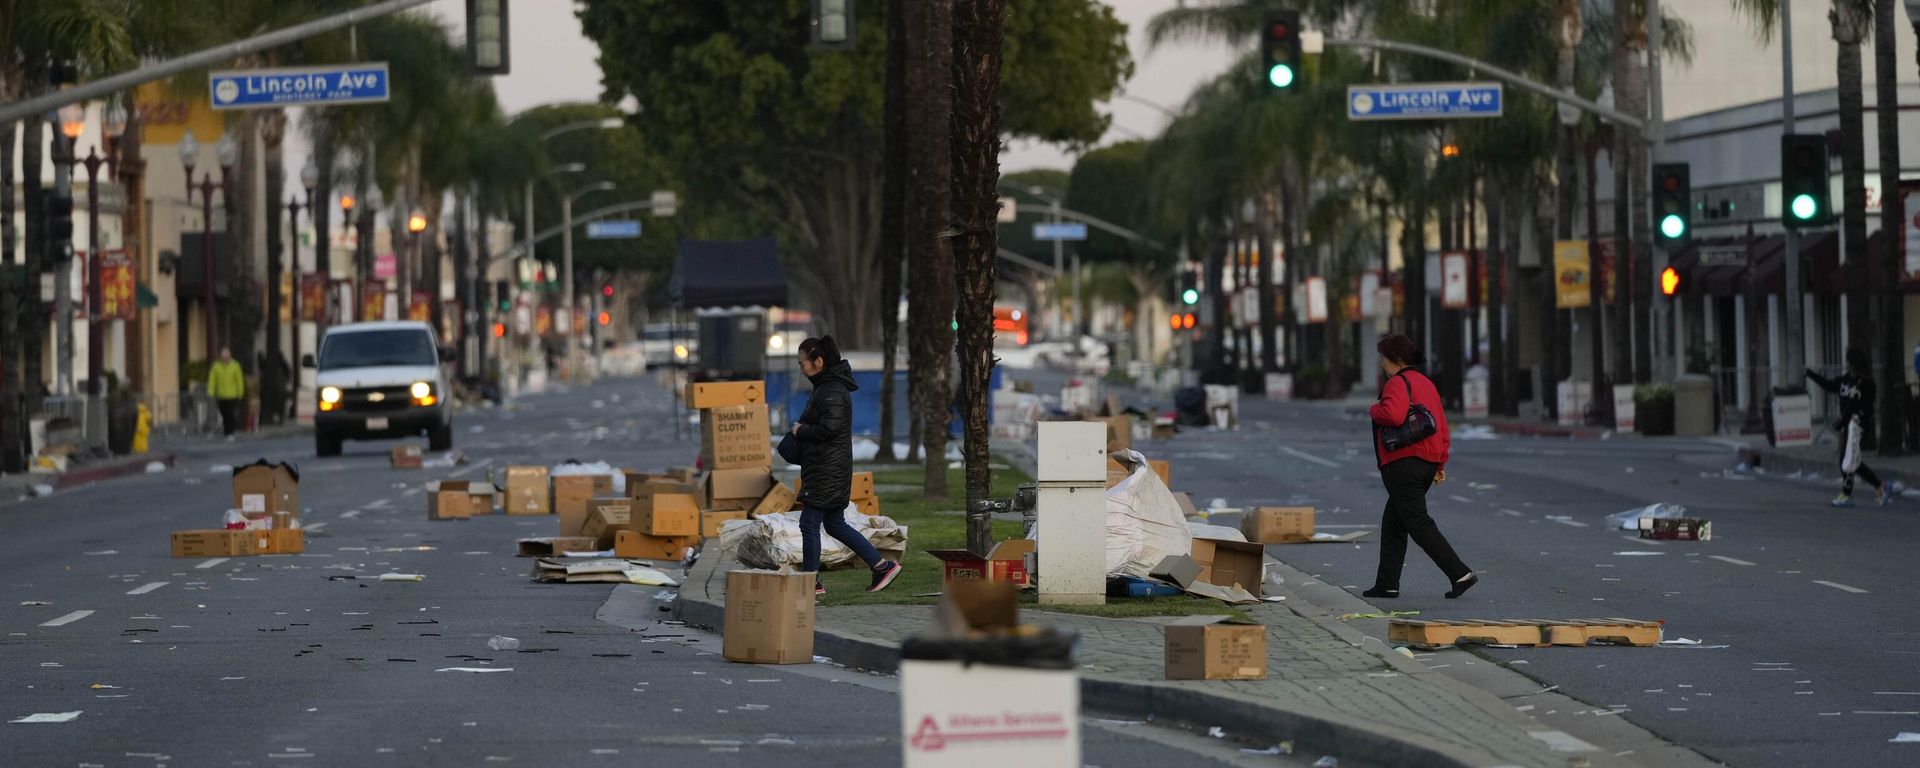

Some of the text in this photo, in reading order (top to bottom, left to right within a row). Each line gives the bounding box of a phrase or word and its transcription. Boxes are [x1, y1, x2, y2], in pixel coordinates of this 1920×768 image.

[247, 72, 377, 95] Lincoln Ave
[273, 92, 322, 100] MONTEREY
[1380, 89, 1492, 107] Lincoln Ave
[718, 412, 754, 421] SHAMMY
[718, 423, 746, 432] CLOTH
[720, 453, 766, 463] MADE IN CHINA
[1003, 711, 1063, 725] Services
